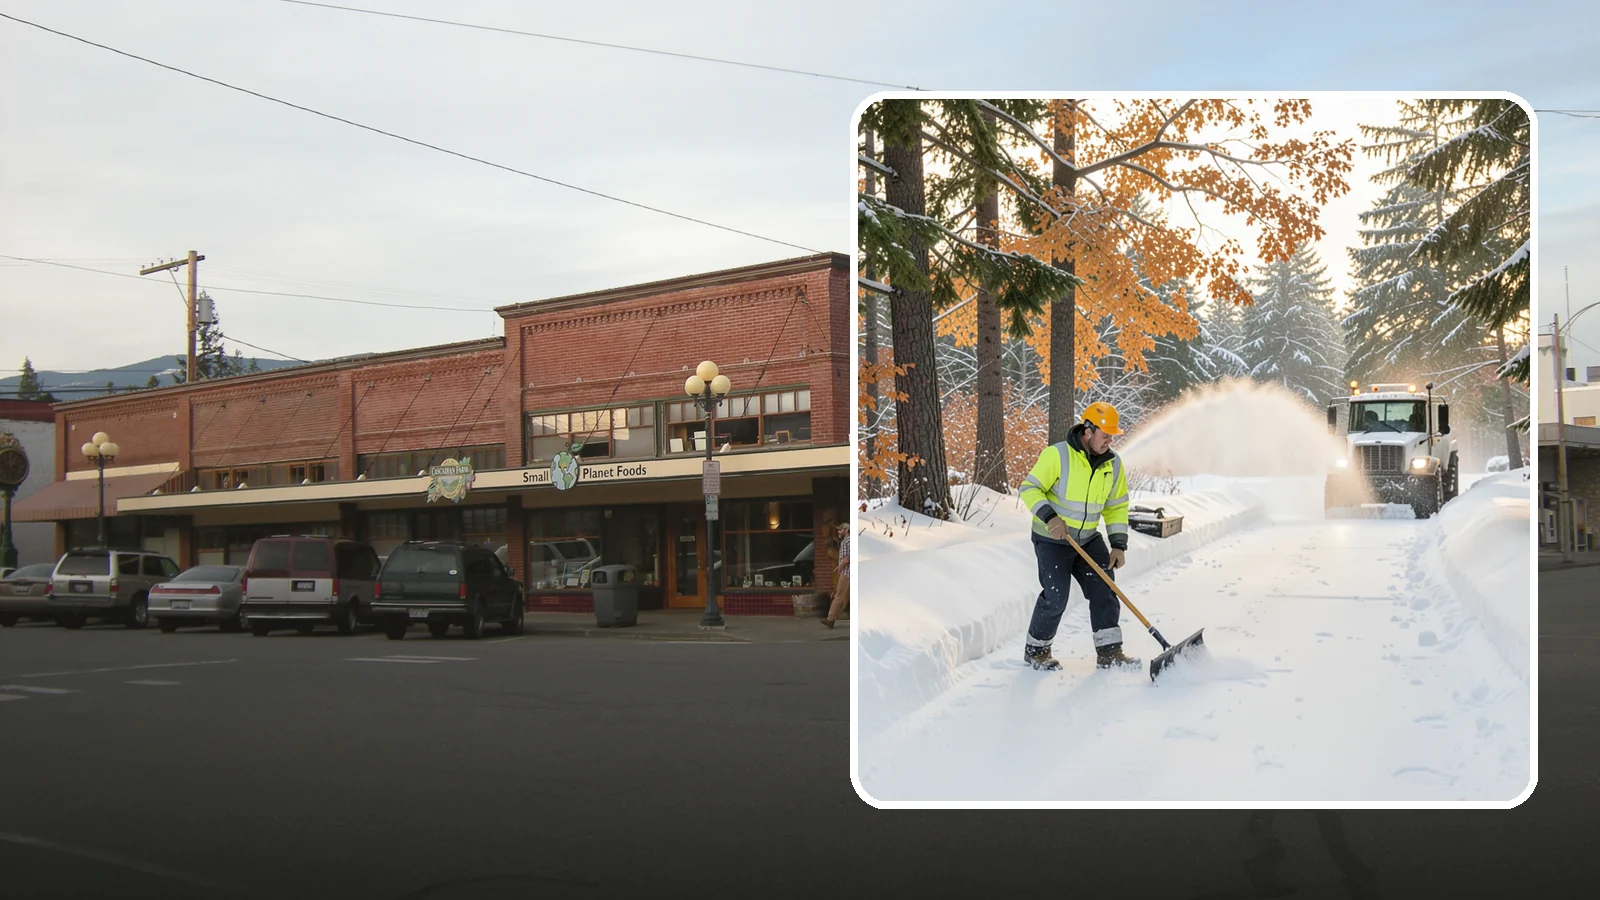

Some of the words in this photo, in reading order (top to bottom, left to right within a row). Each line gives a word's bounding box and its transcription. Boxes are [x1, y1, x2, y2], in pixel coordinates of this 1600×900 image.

[431, 466, 455, 475] CASCADIAN
[523, 471, 549, 483] Small
[582, 467, 614, 479] Planet
[617, 464, 647, 477] Foods
